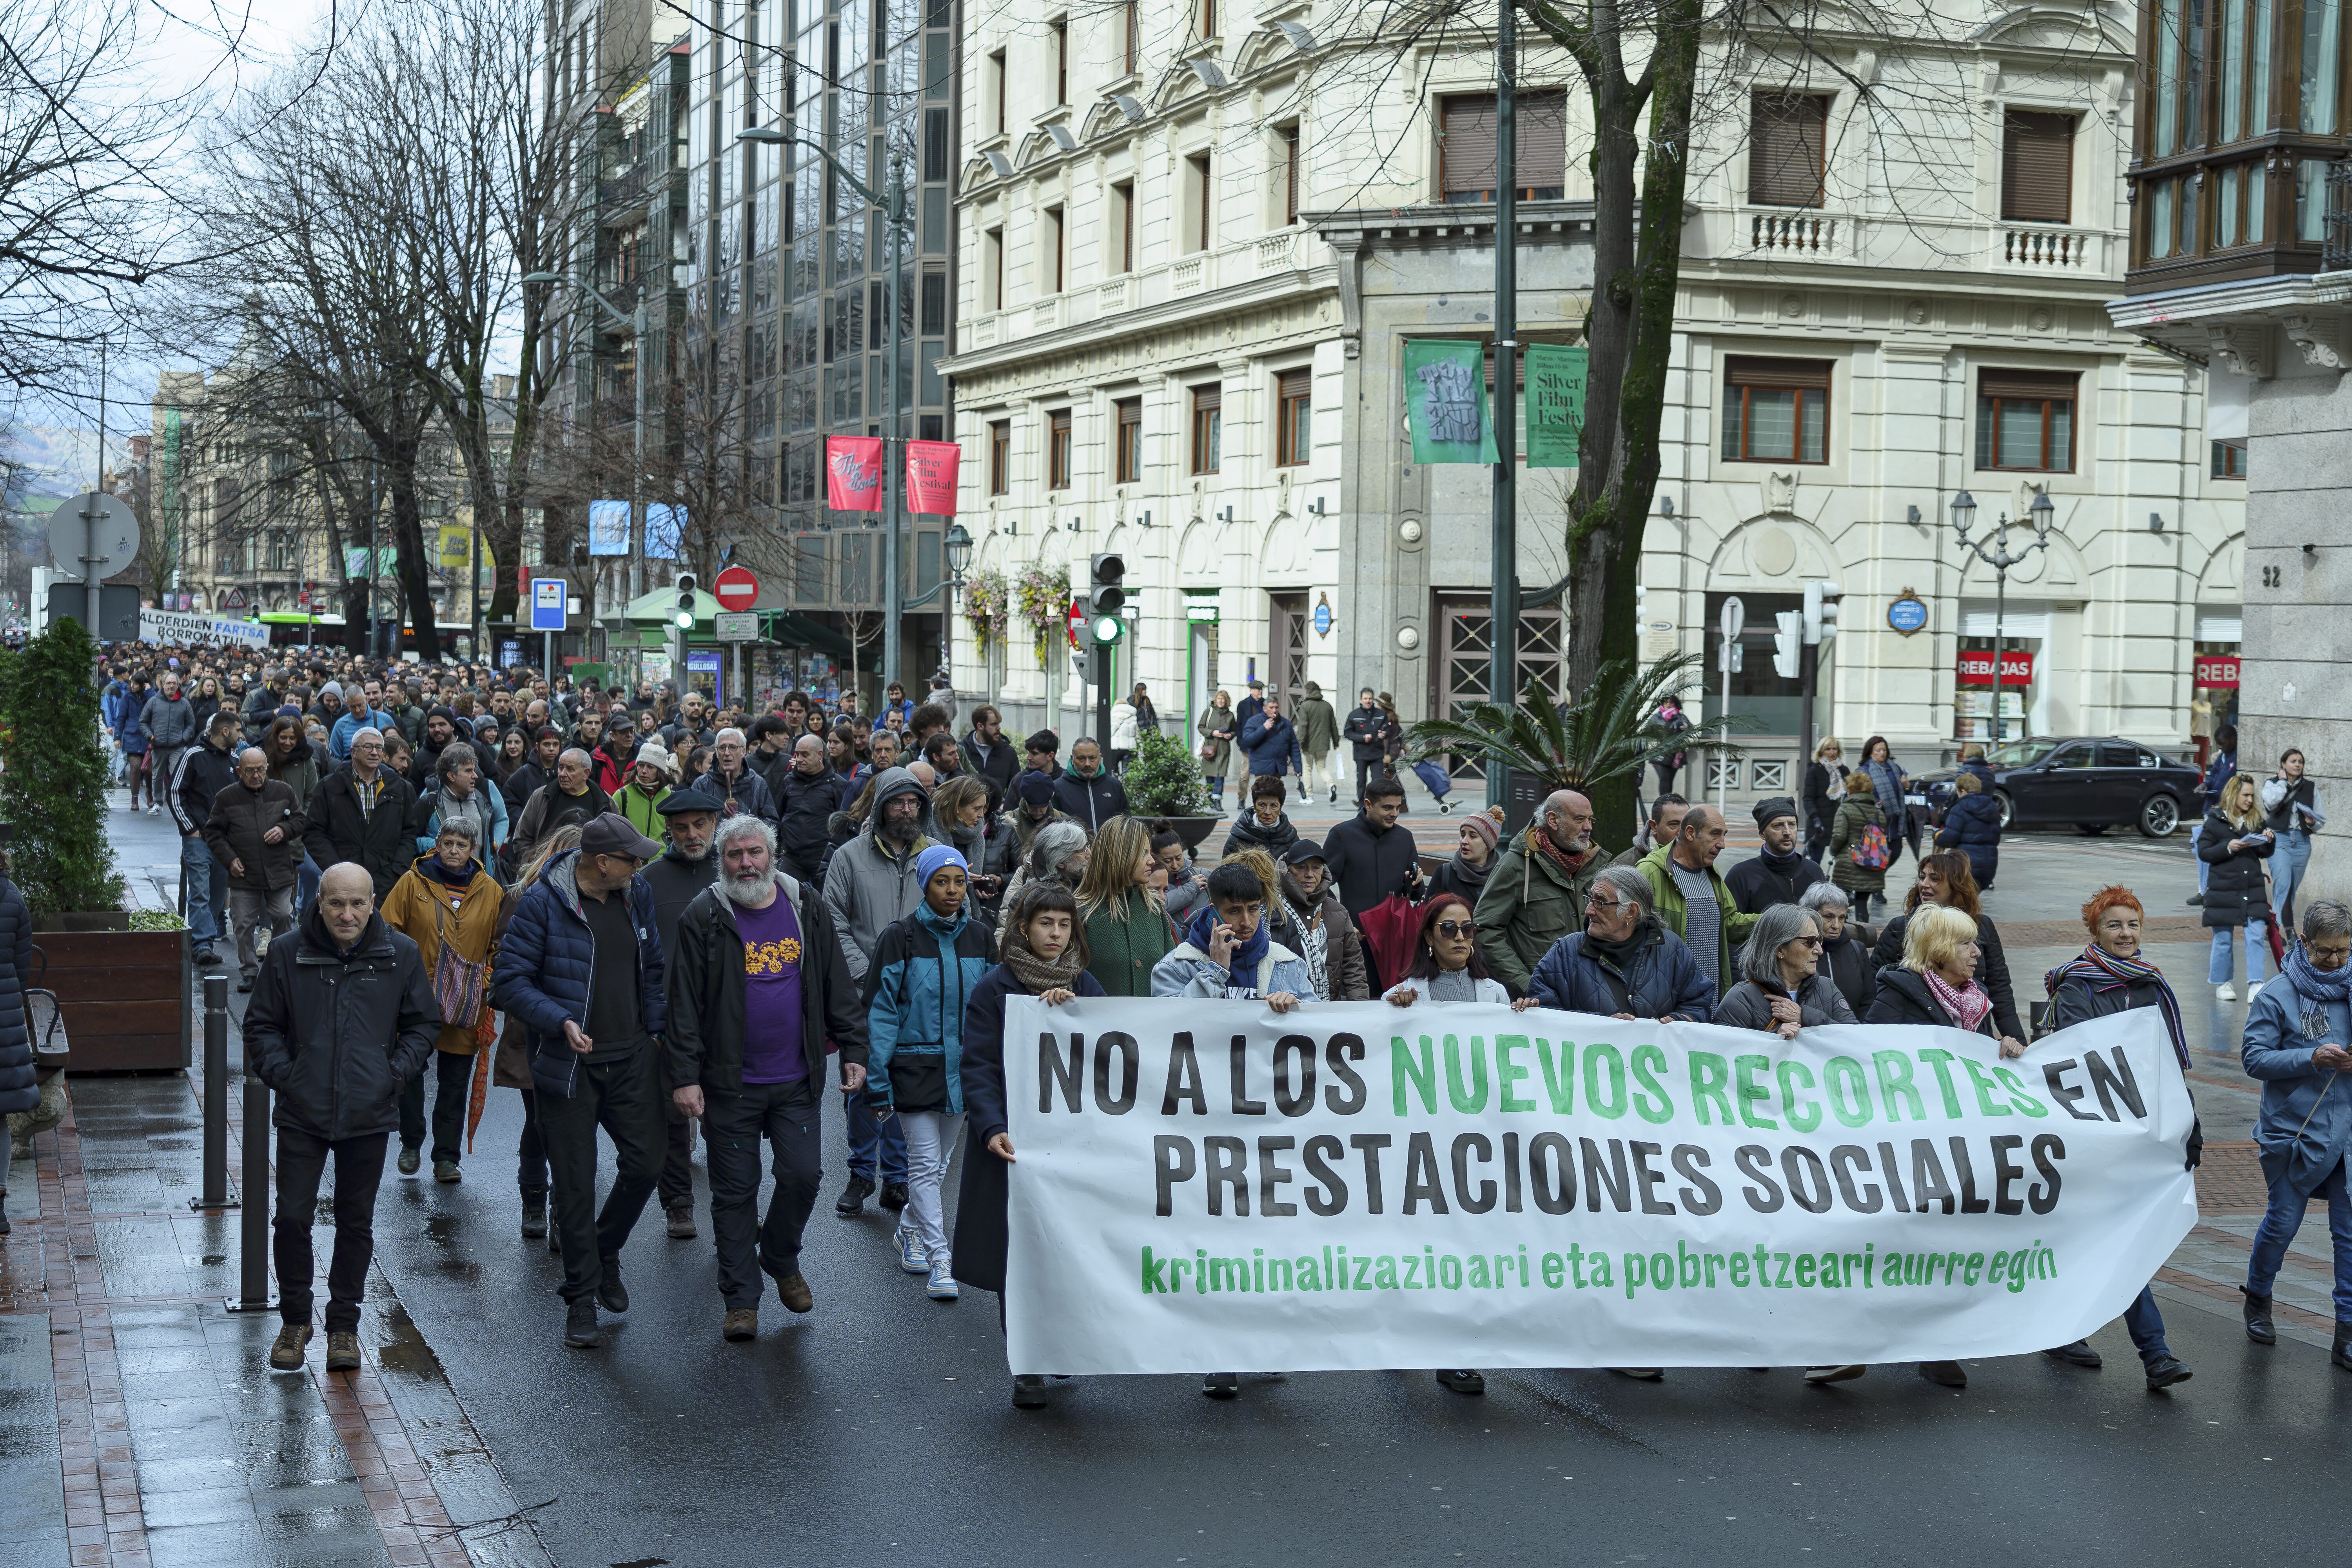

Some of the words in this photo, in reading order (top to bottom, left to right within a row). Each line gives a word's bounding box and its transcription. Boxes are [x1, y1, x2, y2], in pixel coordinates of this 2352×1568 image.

[1537, 373, 1581, 390] Silver
[1537, 391, 1573, 407] Film
[1537, 409, 1584, 425] Festiv
[832, 452, 862, 477] The
[914, 457, 942, 468] Silver
[914, 467, 936, 477] Film
[849, 469, 877, 491] End
[914, 478, 950, 490] Festival
[2262, 565, 2281, 587] 32
[140, 613, 212, 632] ALDERDIEN
[215, 622, 265, 640] FARTSA
[2197, 664, 2240, 681] REB
[1038, 1031, 1139, 1116] NO
[1161, 1031, 1208, 1116] A
[1230, 1032, 1367, 1117] LOS
[1390, 1033, 1675, 1125] NUEVOS
[1687, 1048, 2049, 1134] RECORTES
[2042, 1045, 2148, 1122] EN
[1154, 1132, 1723, 1217] PRESTACIONES
[1734, 1134, 2066, 1216] SOCIALES
[1142, 1243, 1530, 1295] kriminalizazioari
[1541, 1242, 1615, 1290] eta
[1623, 1239, 1875, 1299] pobretzeari
[1882, 1249, 1985, 1287] aurre
[1987, 1239, 2058, 1294] egin
